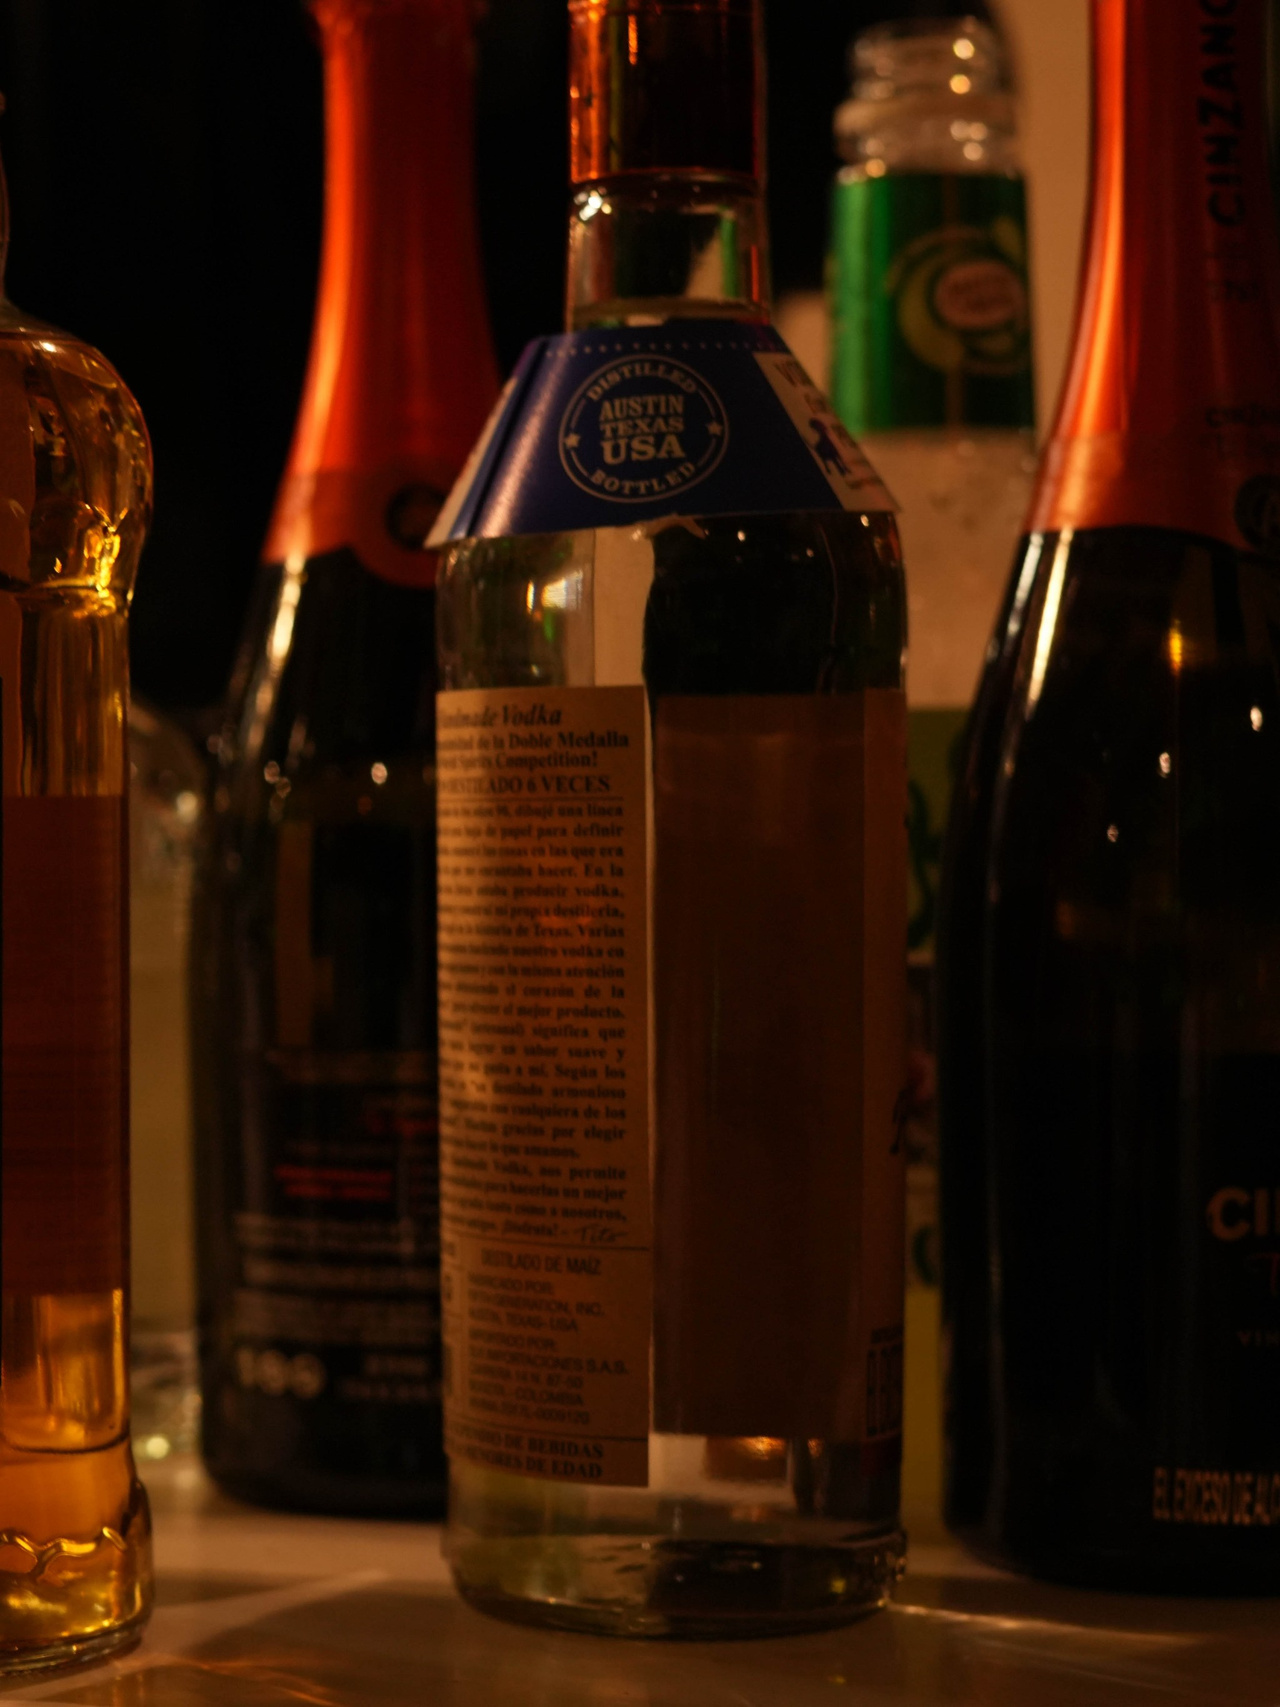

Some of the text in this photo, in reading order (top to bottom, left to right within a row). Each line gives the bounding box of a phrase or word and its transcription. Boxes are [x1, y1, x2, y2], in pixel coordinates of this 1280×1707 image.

[586, 362, 697, 400] DISTILLED
[599, 394, 685, 422] AUSTIN
[600, 416, 685, 439] TEXAS
[600, 433, 686, 466] USA
[590, 461, 695, 495] BOTTLED
[502, 703, 562, 727] Vodka
[508, 732, 553, 750] Doble
[558, 729, 629, 749] Medalla
[495, 750, 598, 772] Competition!
[541, 774, 612, 793] VECES
[573, 822, 625, 838] definir
[610, 983, 625, 999] la
[598, 1027, 625, 1042] que
[569, 1165, 627, 1182] permite
[1206, 1185, 1280, 1244] CI
[545, 1254, 562, 1273] DE
[528, 1436, 604, 1459] BEBIDAS
[526, 1456, 545, 1474] DE
[551, 1459, 604, 1479] EDAD
